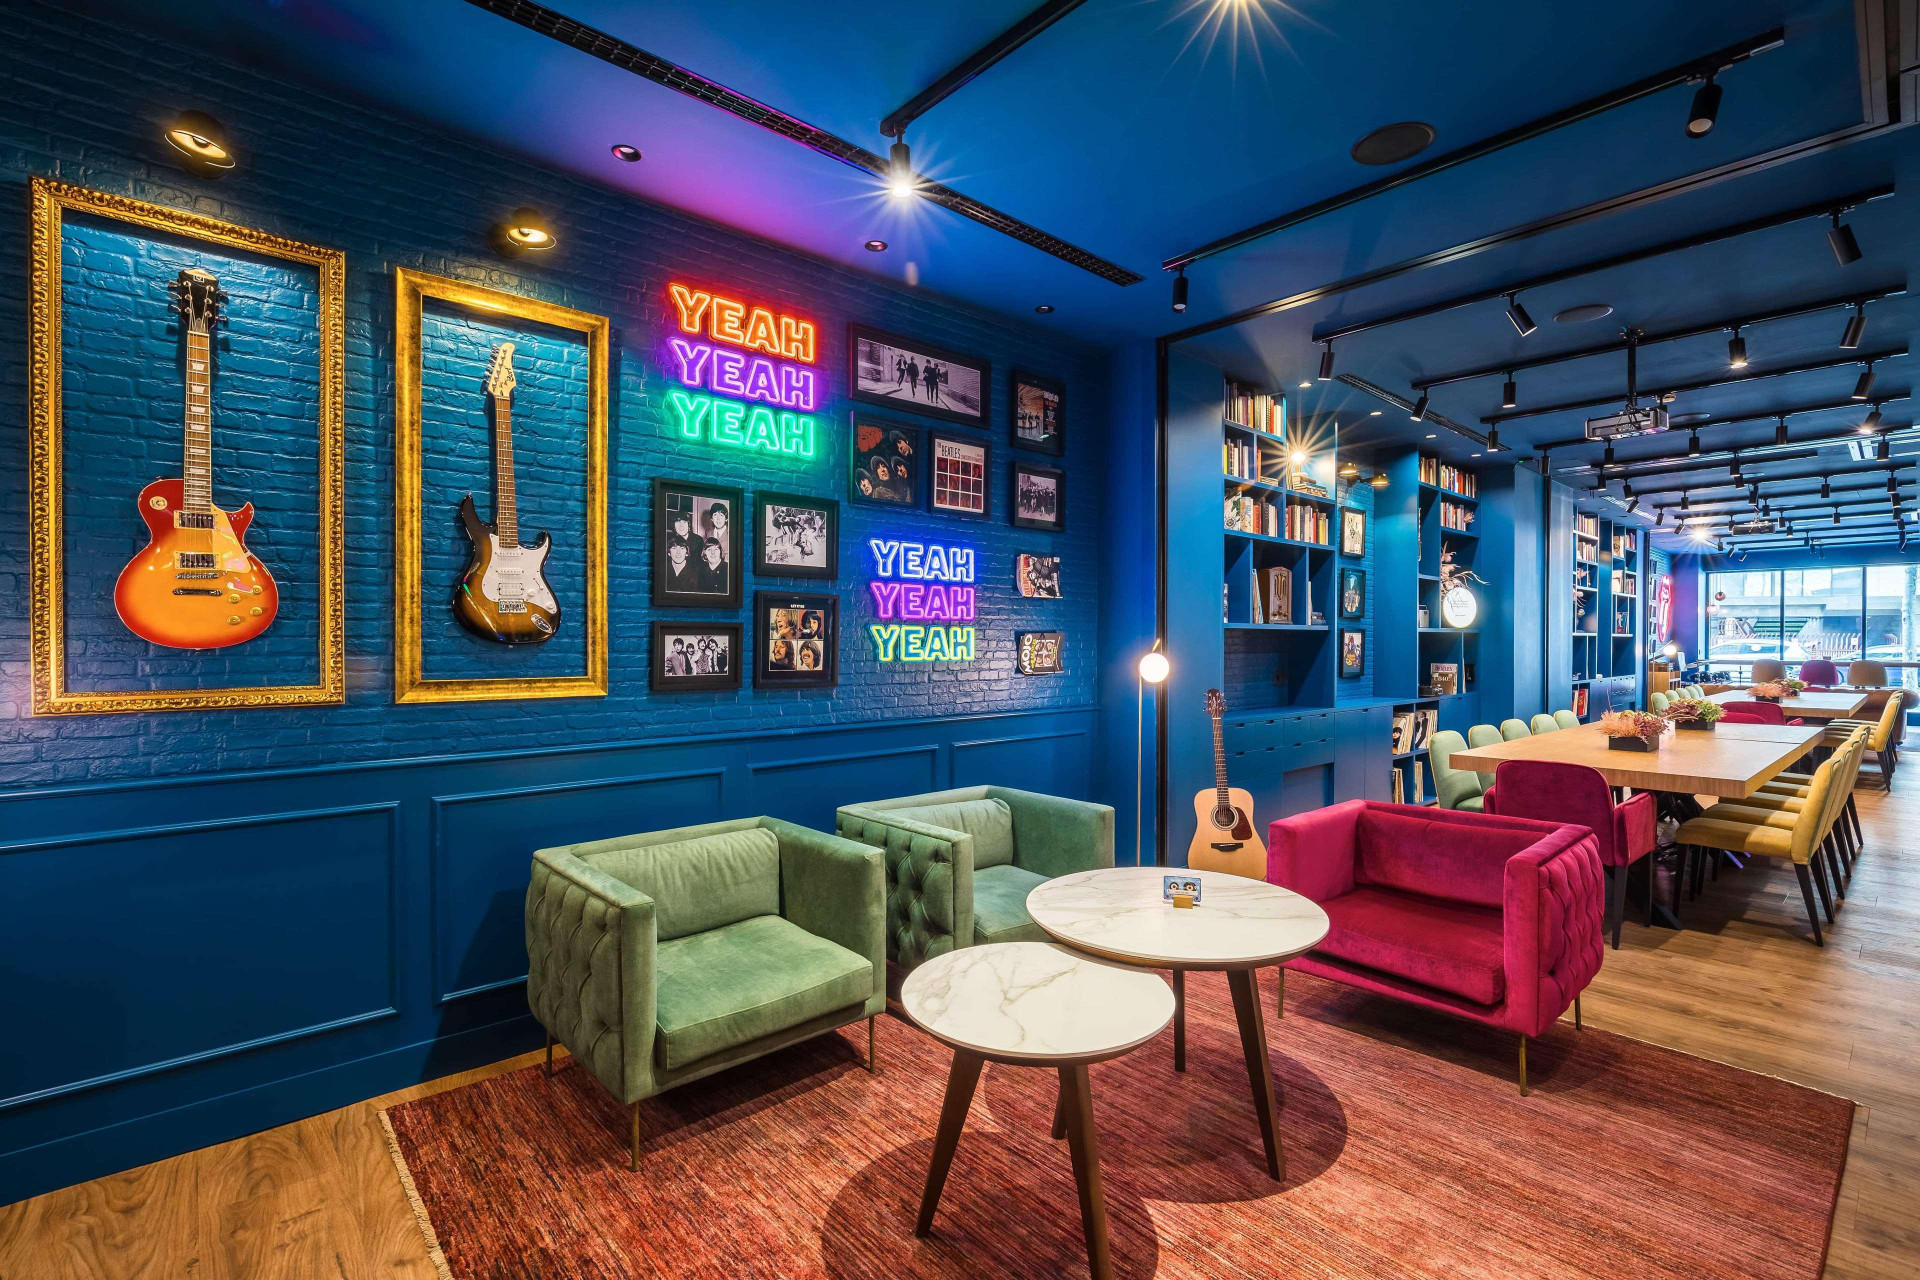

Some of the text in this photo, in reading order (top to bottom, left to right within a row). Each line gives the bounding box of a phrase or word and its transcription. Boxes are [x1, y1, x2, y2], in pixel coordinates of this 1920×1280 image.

[671, 284, 815, 362] YEAH
[671, 338, 814, 410] YEAH
[671, 392, 814, 456] YEAH
[941, 445, 961, 459] BEATLES
[869, 539, 975, 582] YEAH
[869, 582, 975, 620] YEAH
[870, 625, 975, 661] YEAH
[1022, 633, 1033, 673] MOJO
